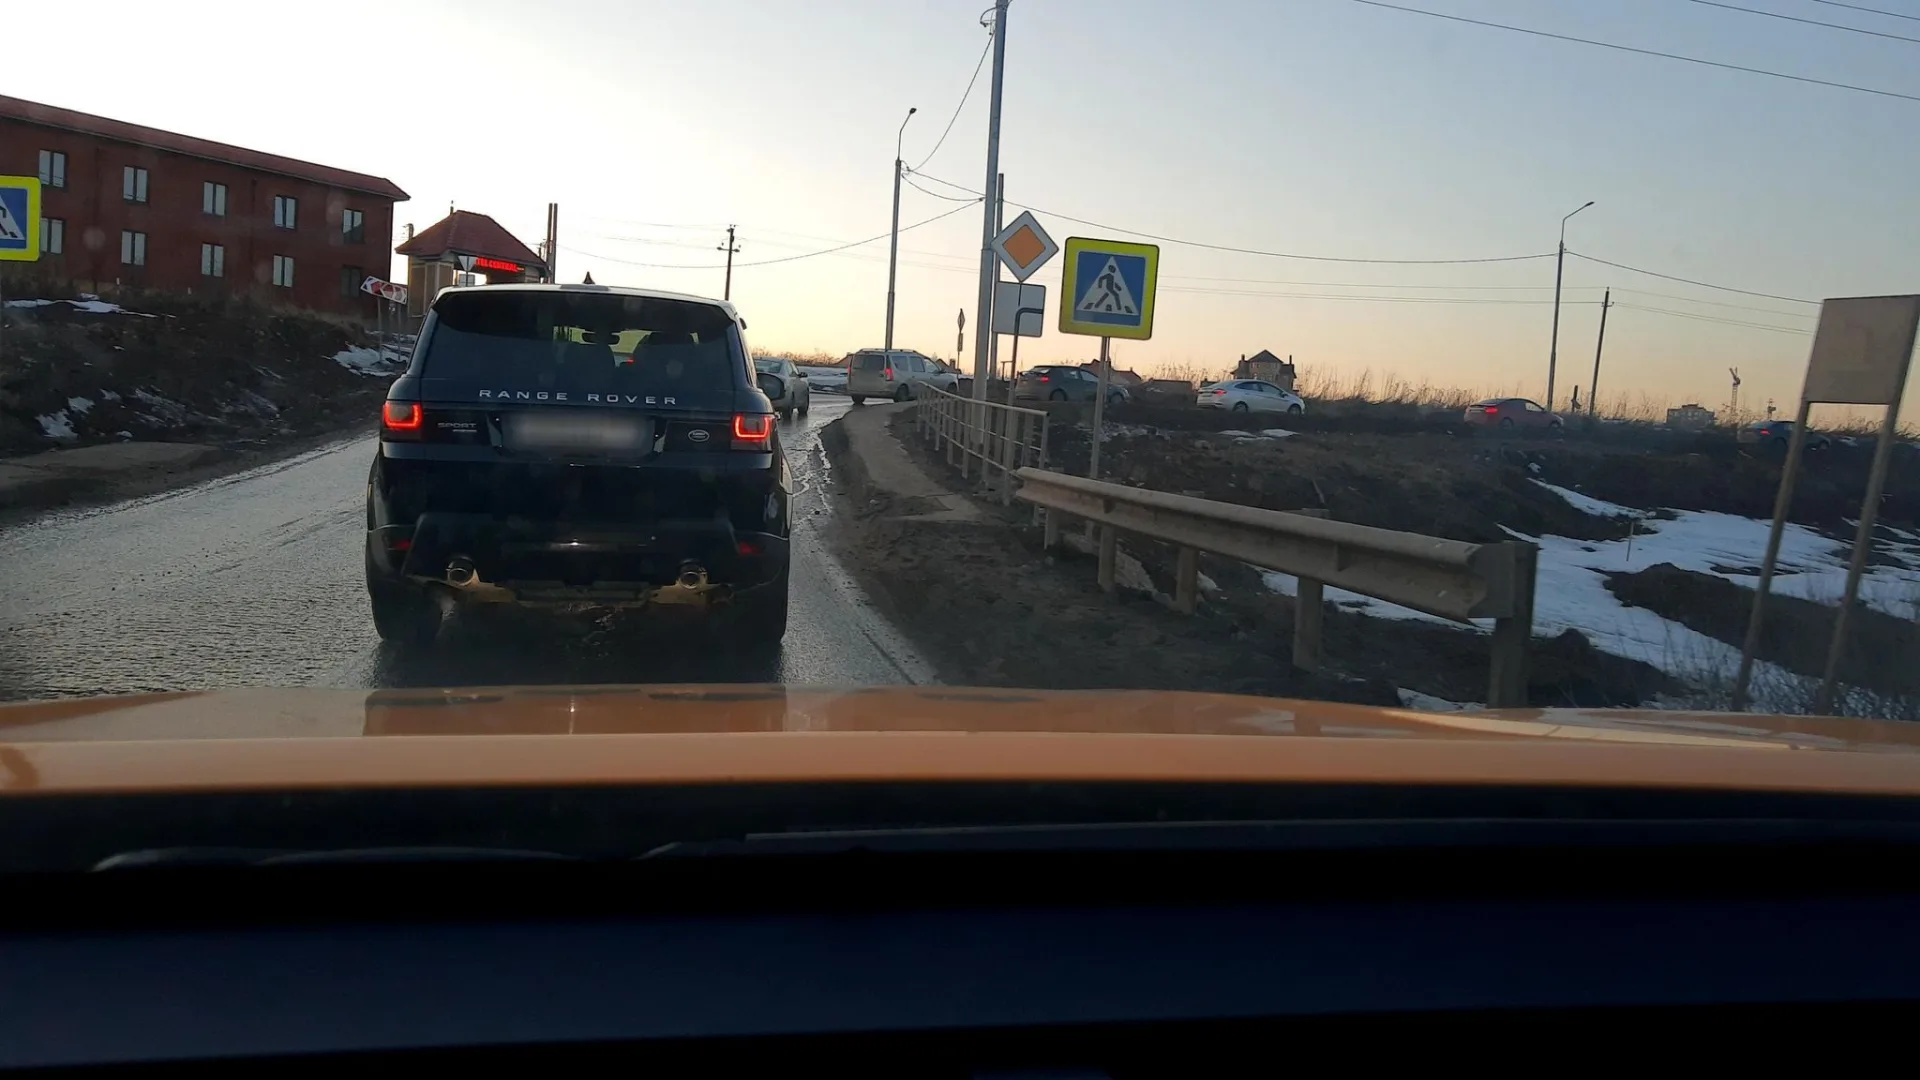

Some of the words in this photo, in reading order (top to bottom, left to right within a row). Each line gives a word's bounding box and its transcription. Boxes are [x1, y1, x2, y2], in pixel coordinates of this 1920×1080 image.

[489, 259, 519, 272] CENTRAL
[479, 389, 568, 401] RANGE
[587, 393, 676, 405] ROVER
